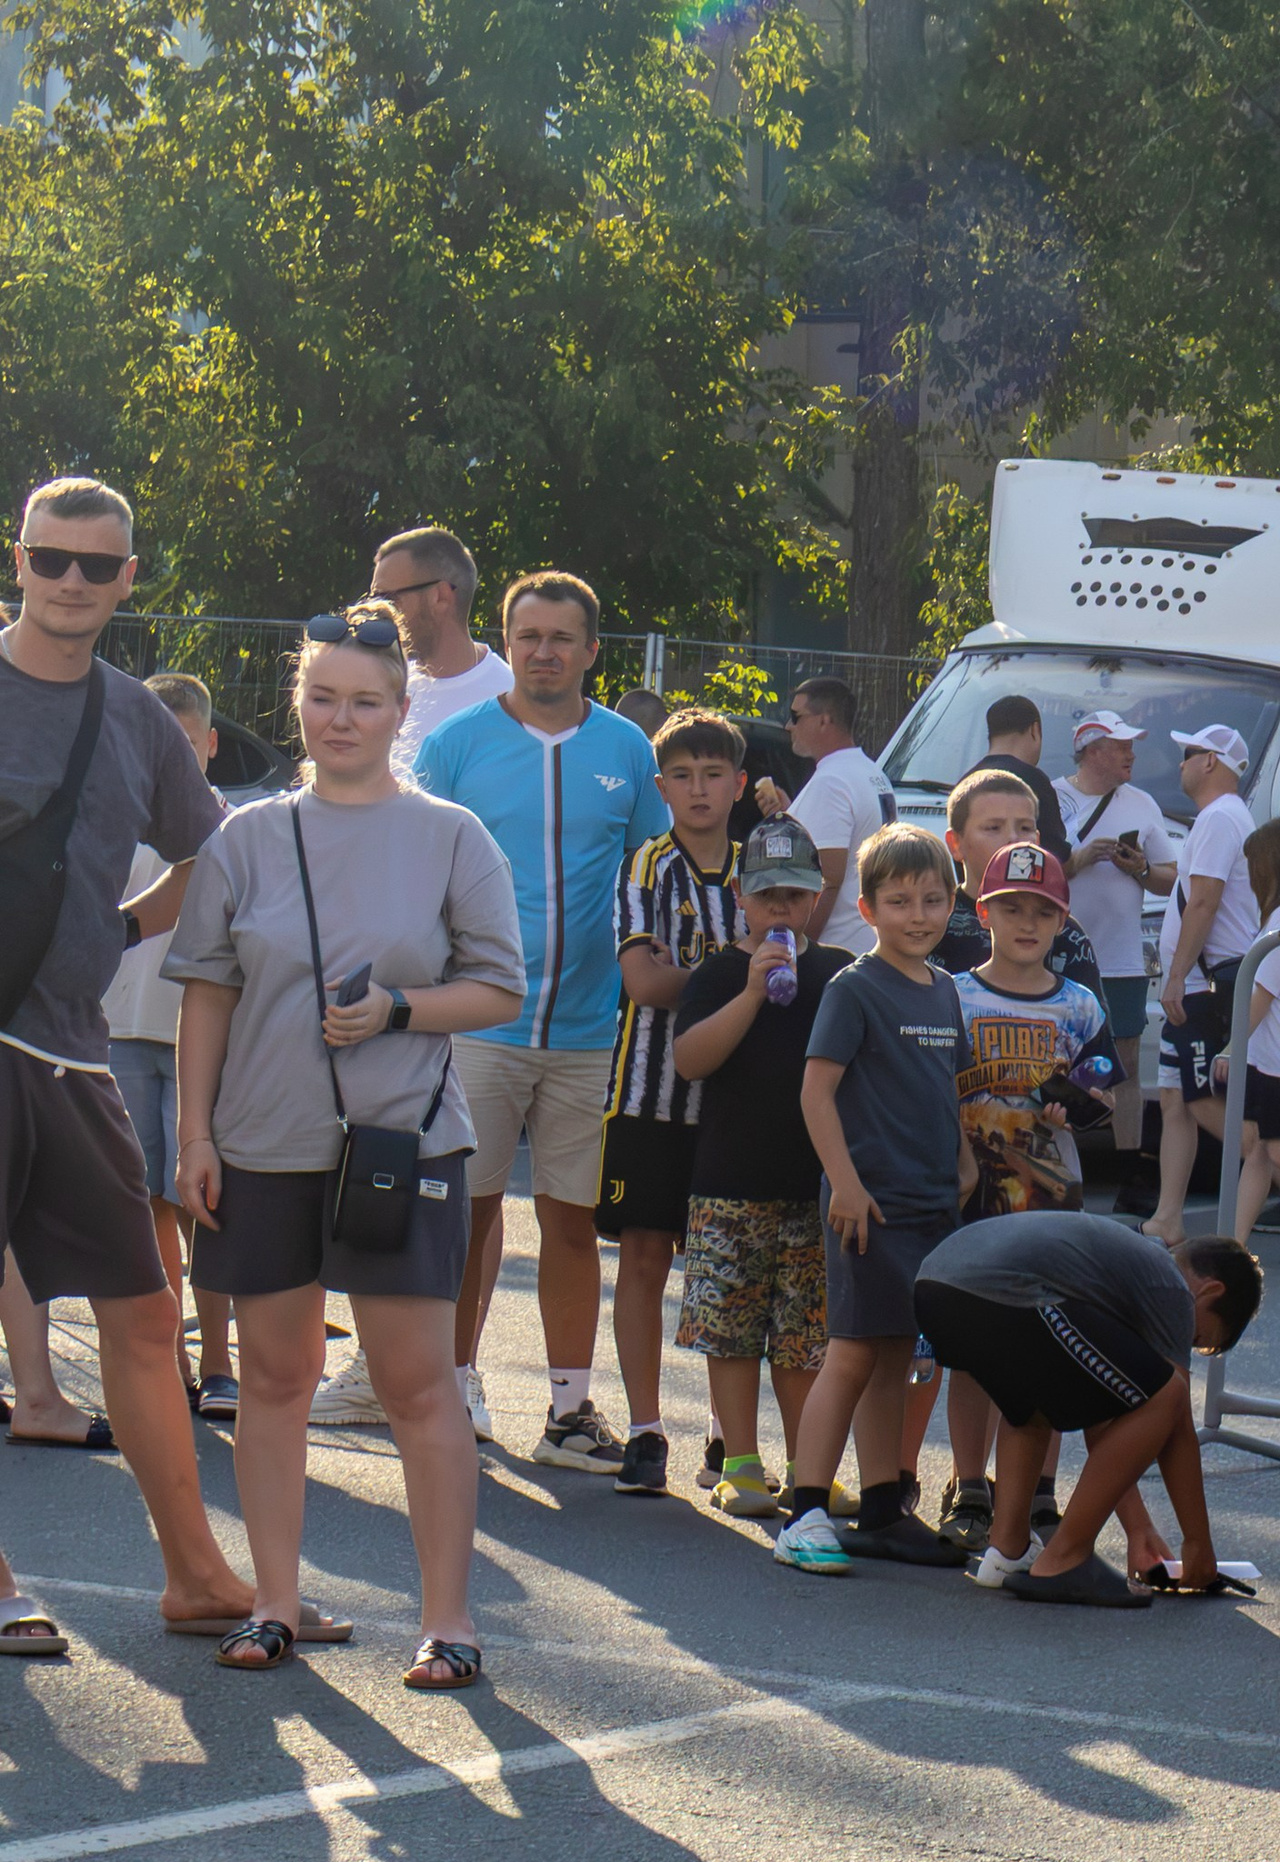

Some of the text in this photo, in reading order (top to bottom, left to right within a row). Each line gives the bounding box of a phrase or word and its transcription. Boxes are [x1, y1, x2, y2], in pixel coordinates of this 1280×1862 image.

[918, 1037, 929, 1046] TO
[983, 1025, 1048, 1060] PUBG
[1190, 1040, 1208, 1089] FILA
